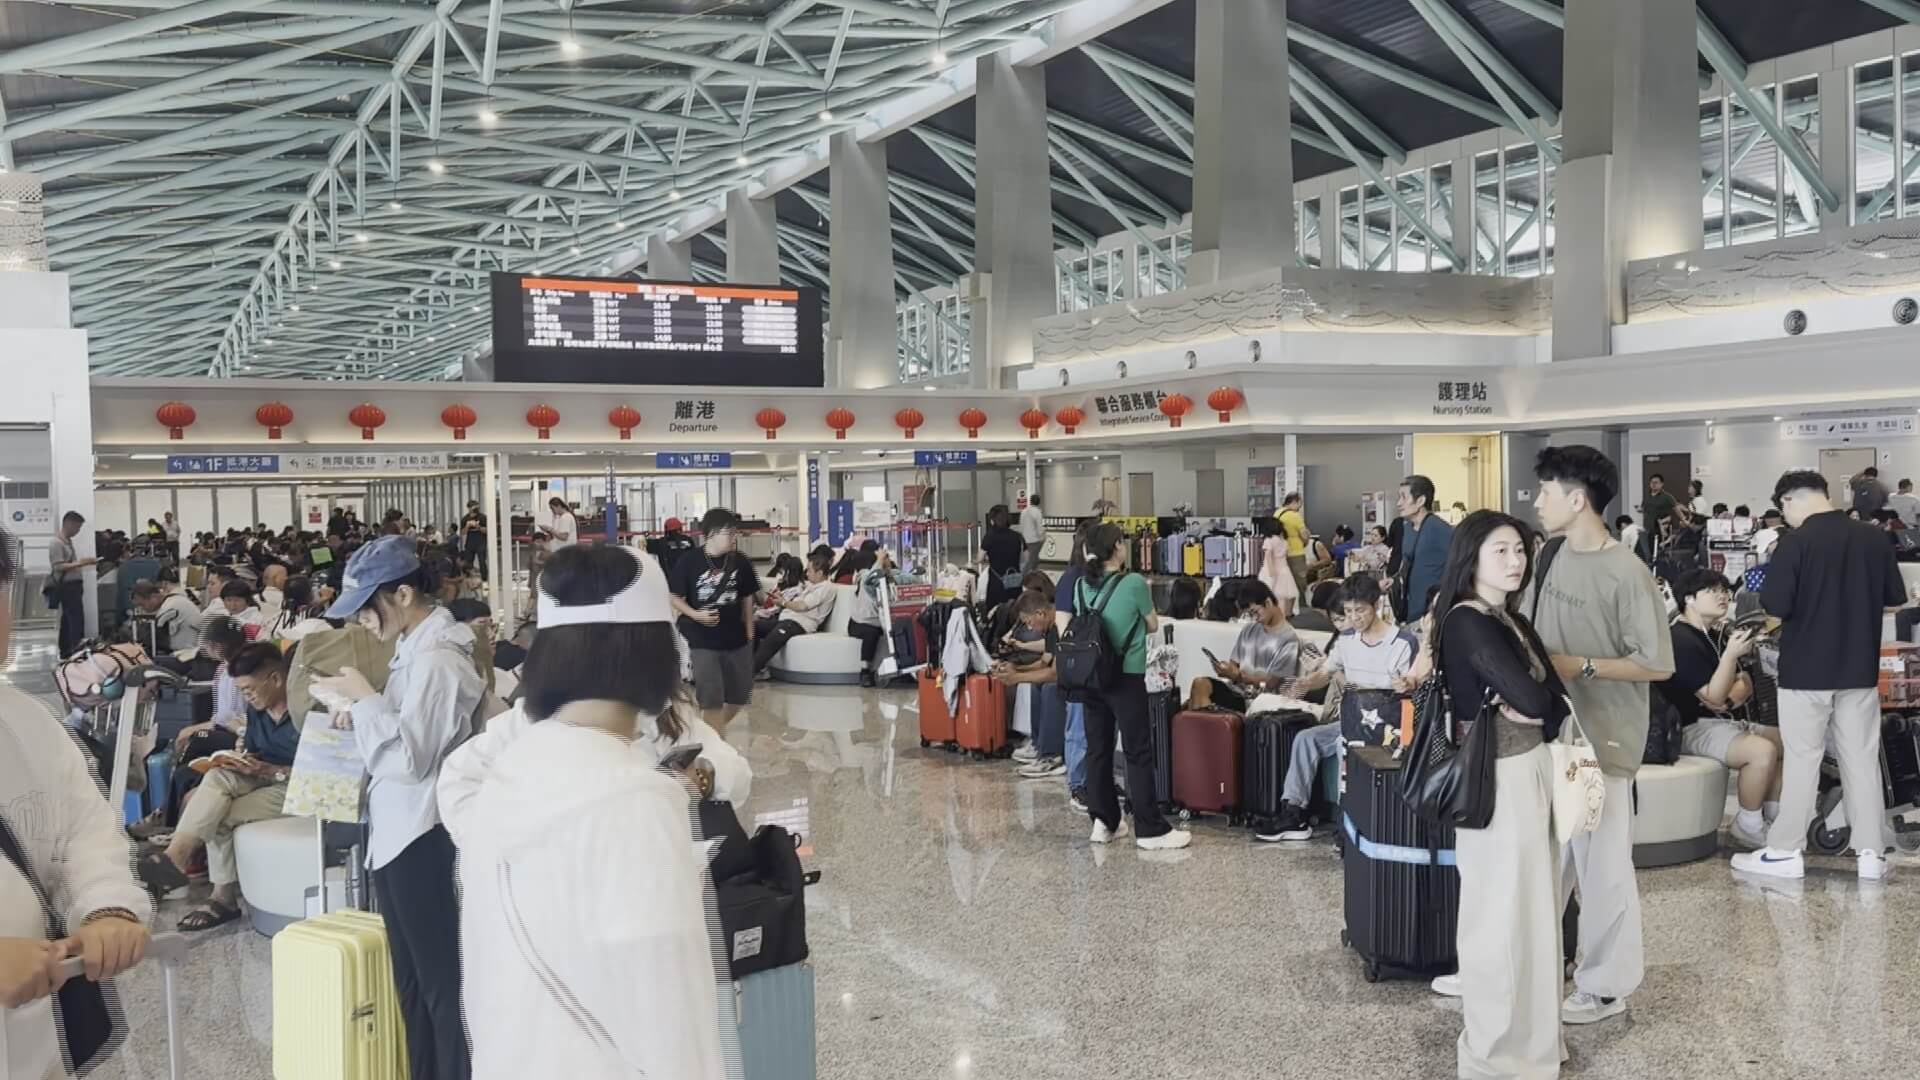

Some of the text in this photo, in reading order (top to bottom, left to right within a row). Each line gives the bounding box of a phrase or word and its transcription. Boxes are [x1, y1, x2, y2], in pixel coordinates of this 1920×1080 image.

[1438, 381, 1487, 401] 護理站
[674, 400, 715, 420] 離港
[1433, 404, 1492, 416] Nursing Station
[669, 423, 718, 434] Departure
[206, 457, 222, 471] 1F
